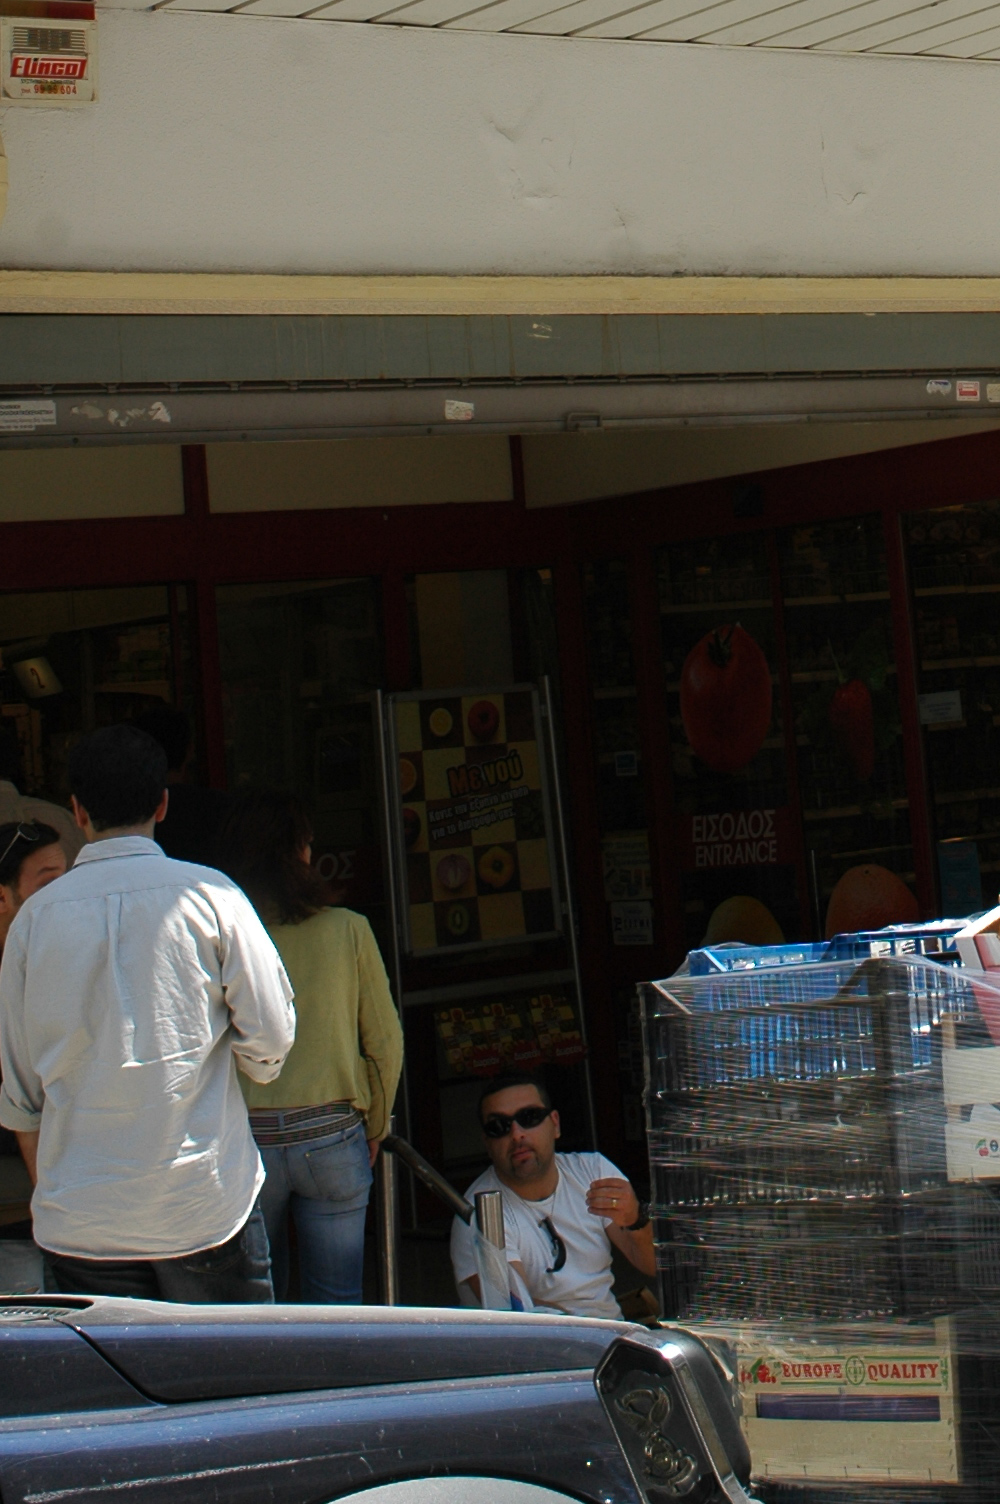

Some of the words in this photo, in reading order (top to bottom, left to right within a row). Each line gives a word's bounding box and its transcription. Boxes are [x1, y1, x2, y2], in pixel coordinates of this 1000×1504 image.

[692, 809, 776, 843] ΕΙΣΟΔΟΣ
[695, 839, 778, 868] ENTRANCE
[781, 1362, 843, 1379] EUROPE
[867, 1362, 939, 1382] QUALITY
